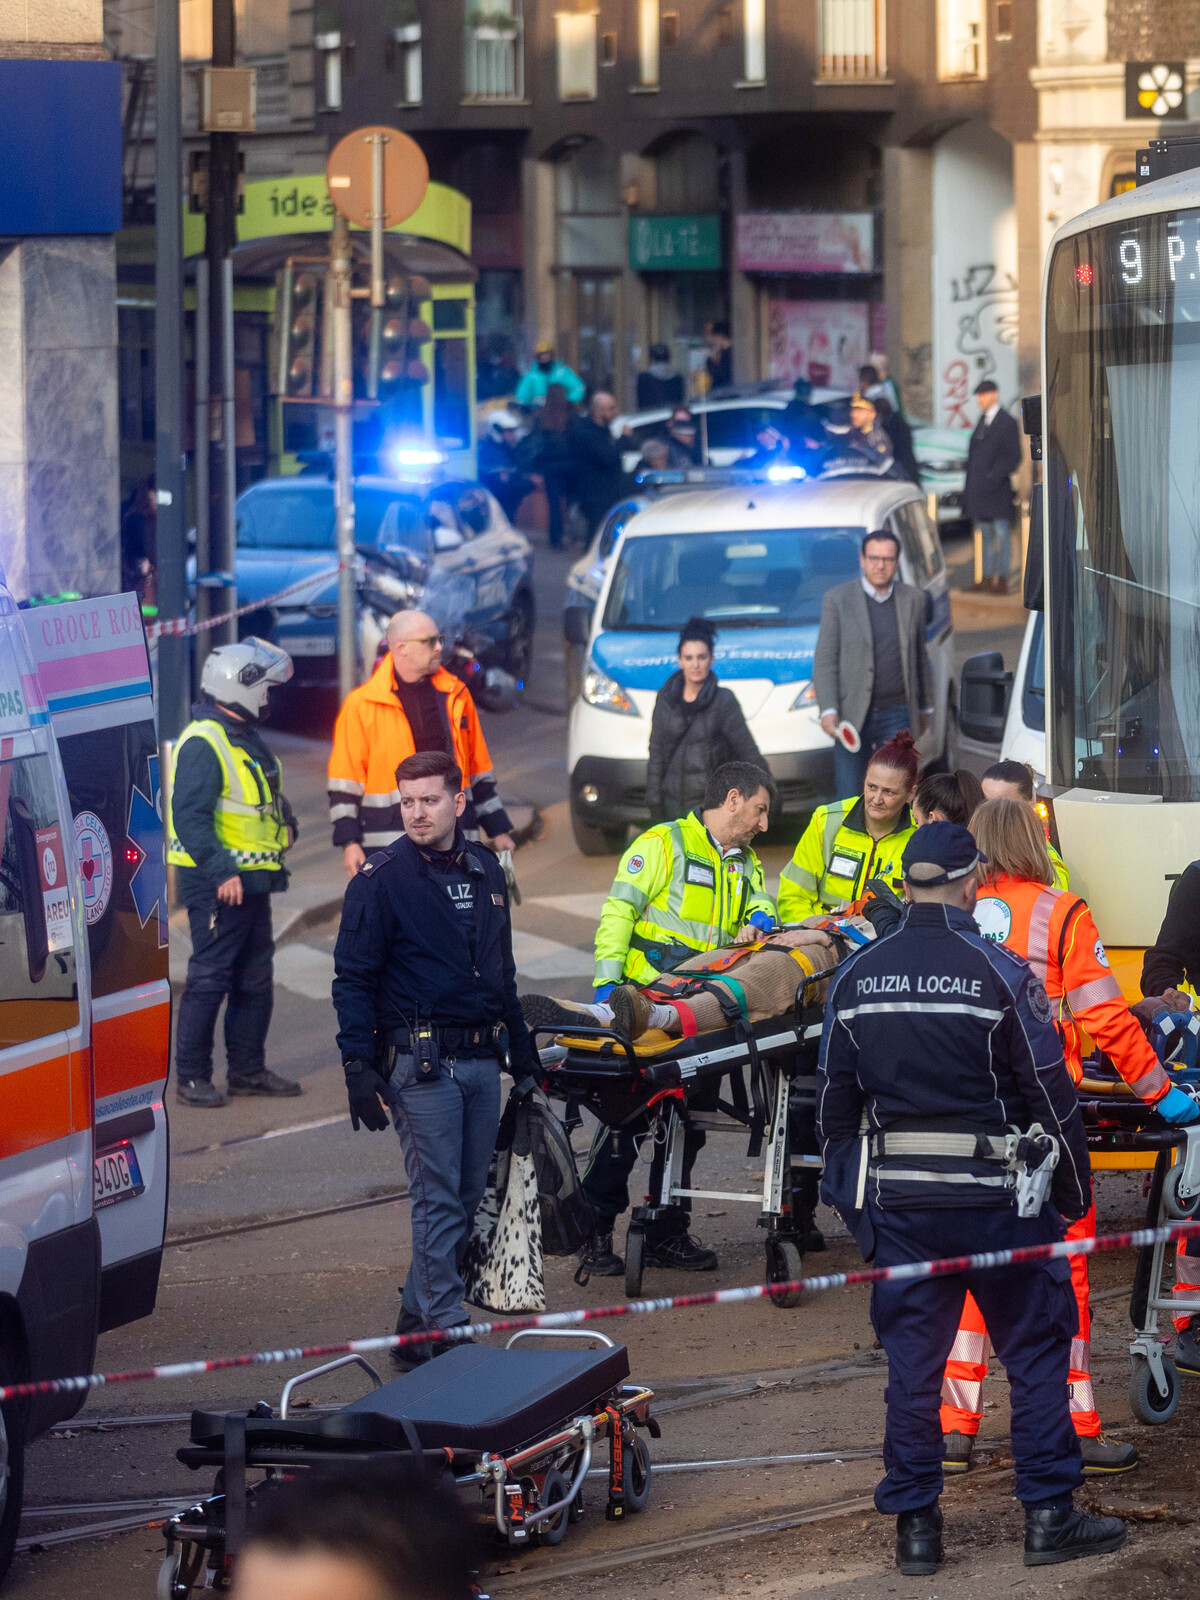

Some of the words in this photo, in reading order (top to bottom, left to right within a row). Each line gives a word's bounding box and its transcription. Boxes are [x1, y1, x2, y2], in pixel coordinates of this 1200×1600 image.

[1119, 239, 1143, 284] 9
[41, 610, 101, 647] CROCE
[0, 688, 24, 718] PAS
[631, 858, 643, 867] 118
[46, 900, 69, 923] AREU
[856, 974, 911, 997] POLIZIA
[917, 975, 982, 998] LOCALE
[612, 1419, 623, 1492] MEBER
